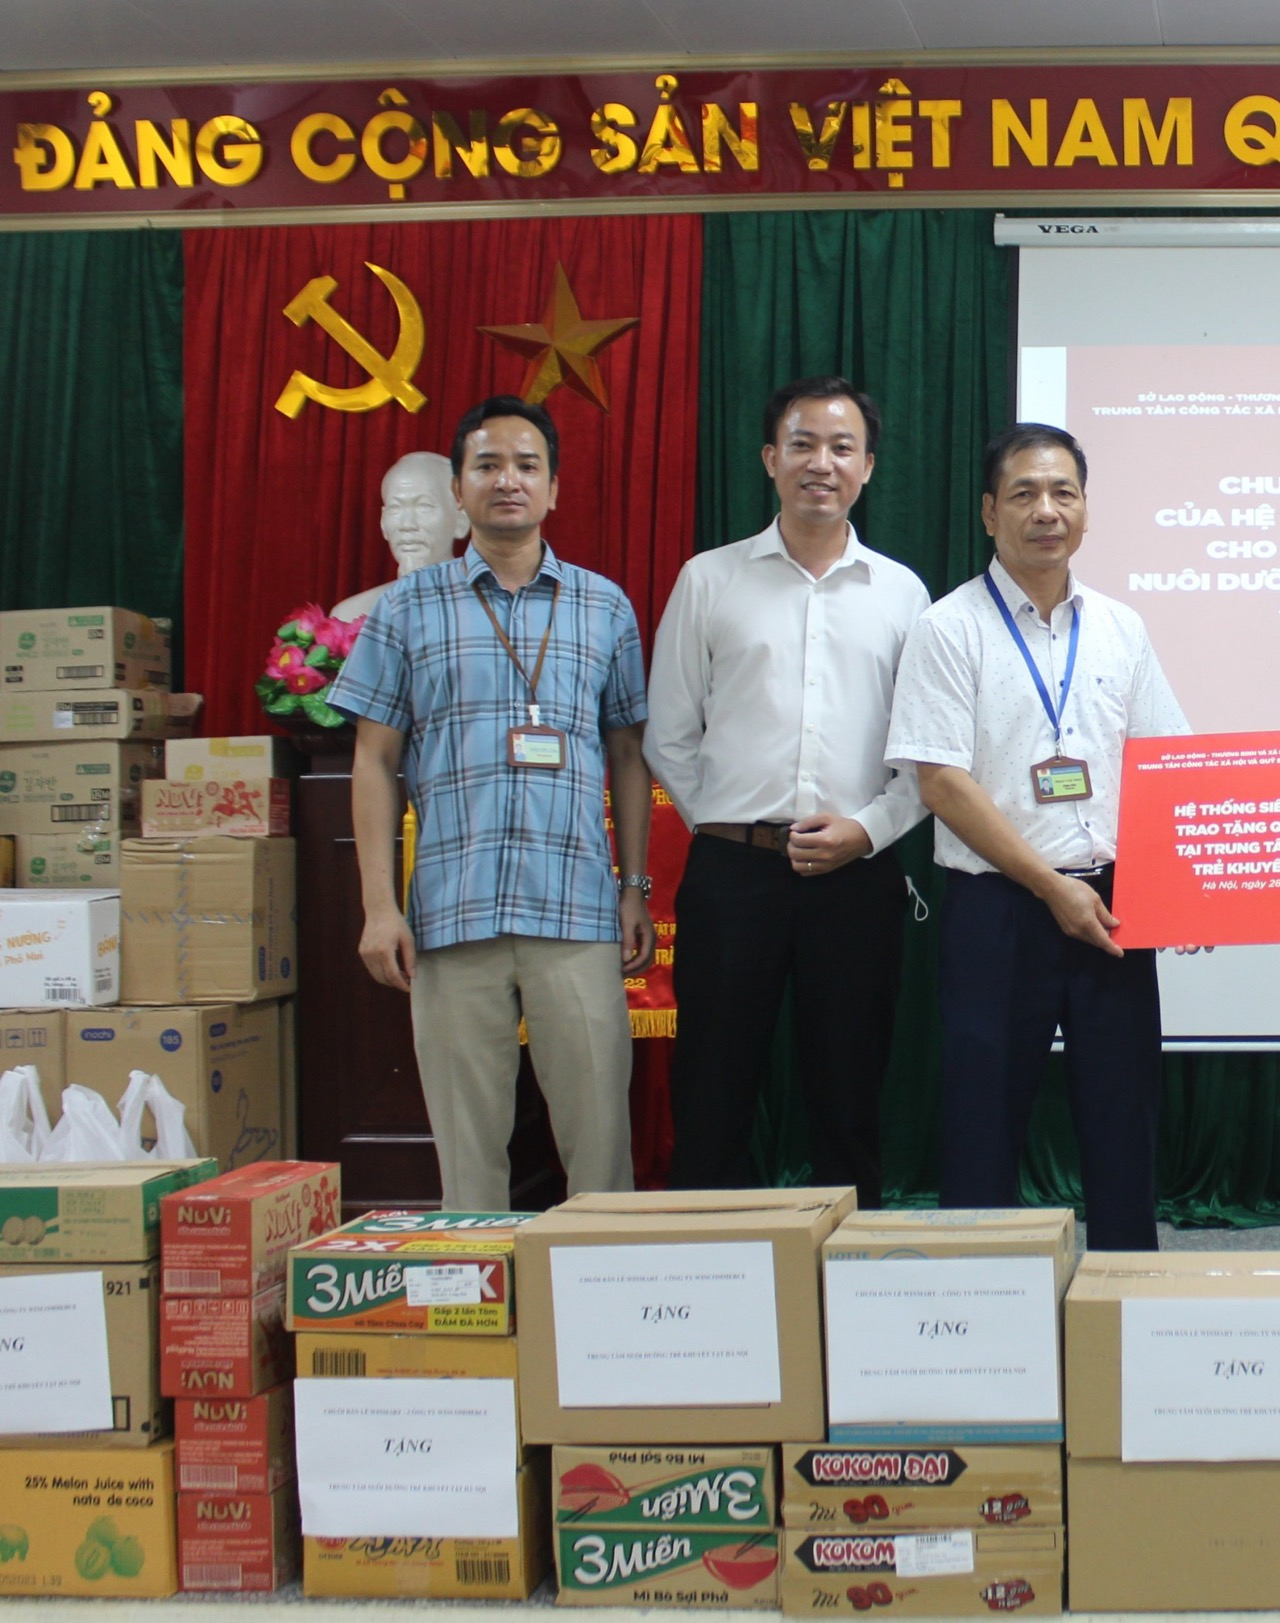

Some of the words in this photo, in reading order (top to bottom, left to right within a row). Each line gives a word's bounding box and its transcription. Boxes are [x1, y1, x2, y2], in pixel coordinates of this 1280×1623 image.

[13, 91, 264, 191] ĐẢNG
[290, 88, 562, 200] CỘNG
[590, 74, 761, 176] SẢN
[789, 77, 963, 188] VIỆT
[990, 96, 1193, 168] NAM
[1037, 223, 1100, 235] VEGA
[1155, 501, 1224, 526] CỦA
[1231, 503, 1275, 529] HỆ
[1206, 540, 1277, 558] CHO
[1129, 568, 1210, 590] NUÔI
[1174, 802, 1196, 818] HỆ
[1199, 799, 1256, 815] THỐNG
[1175, 823, 1219, 836] TRAO
[1222, 819, 1266, 836] TẶNG
[1175, 844, 1201, 858] TẠI
[1204, 841, 1260, 855] TRUNG
[1192, 858, 1223, 875] TRẺ
[1202, 881, 1216, 889] Hà
[1218, 880, 1237, 890] Nội,
[1241, 879, 1266, 890] ngày
[162, 1035, 181, 1045] 185
[106, 1281, 131, 1296] 921
[641, 1303, 692, 1324] TẶNG
[917, 1319, 969, 1340] TẶNG
[1213, 1358, 1265, 1380] TẶNG
[383, 1436, 433, 1457] TẶNG
[812, 1453, 901, 1481] KOKOMI
[903, 1452, 949, 1483] ĐẠI
[25, 1476, 49, 1490] 25%
[52, 1476, 89, 1490] Melon
[93, 1477, 124, 1490] Juice
[128, 1477, 155, 1490] with
[73, 1494, 101, 1506] nata
[107, 1494, 123, 1507] de
[125, 1496, 154, 1507] coco
[812, 1538, 896, 1565] KOKOM
